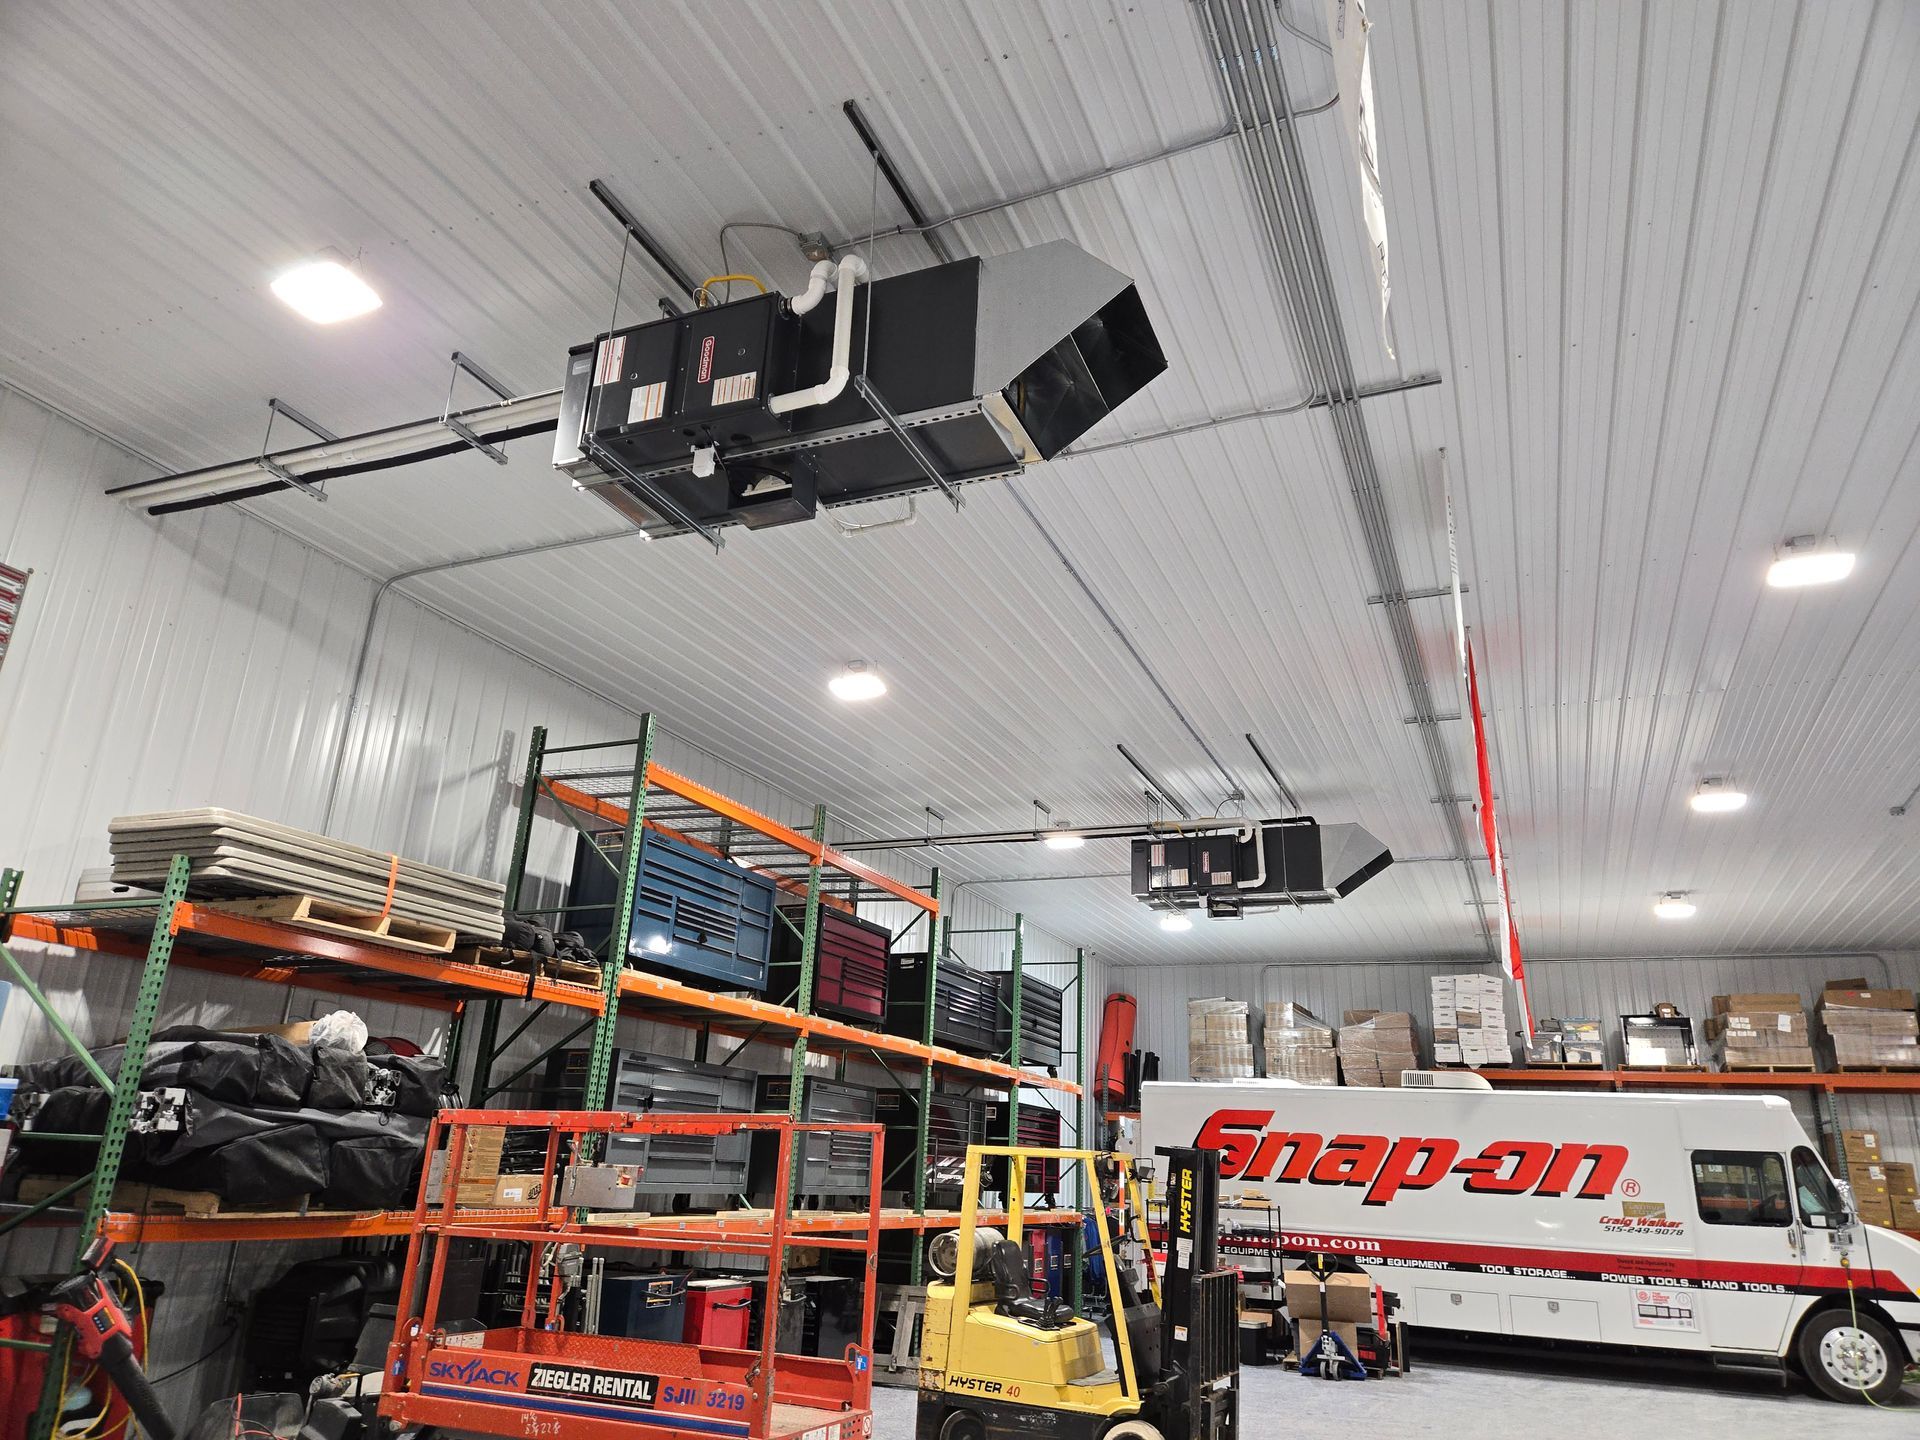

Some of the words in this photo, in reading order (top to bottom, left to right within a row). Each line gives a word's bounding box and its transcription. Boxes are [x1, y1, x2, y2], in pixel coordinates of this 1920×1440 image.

[701, 338, 713, 380] Goodman
[1193, 1109, 1629, 1206] Snap-on
[1179, 1168, 1193, 1233] HYSTER
[1599, 1216, 1634, 1227] Craig
[1637, 1217, 1684, 1228] Walker
[1603, 1225, 1684, 1236] 515-249-9078
[1355, 1255, 1384, 1265] SHOP
[1480, 1264, 1510, 1274] TOOL
[1601, 1273, 1645, 1285] POWER
[1702, 1280, 1738, 1291] HAND
[429, 1358, 520, 1388] SKYJACK
[530, 1368, 592, 1393] ZIEGLER
[592, 1375, 652, 1401] RENTAL
[949, 1375, 1002, 1394] HYSTER
[1006, 1385, 1021, 1398] 40
[706, 1391, 745, 1411] 3219
